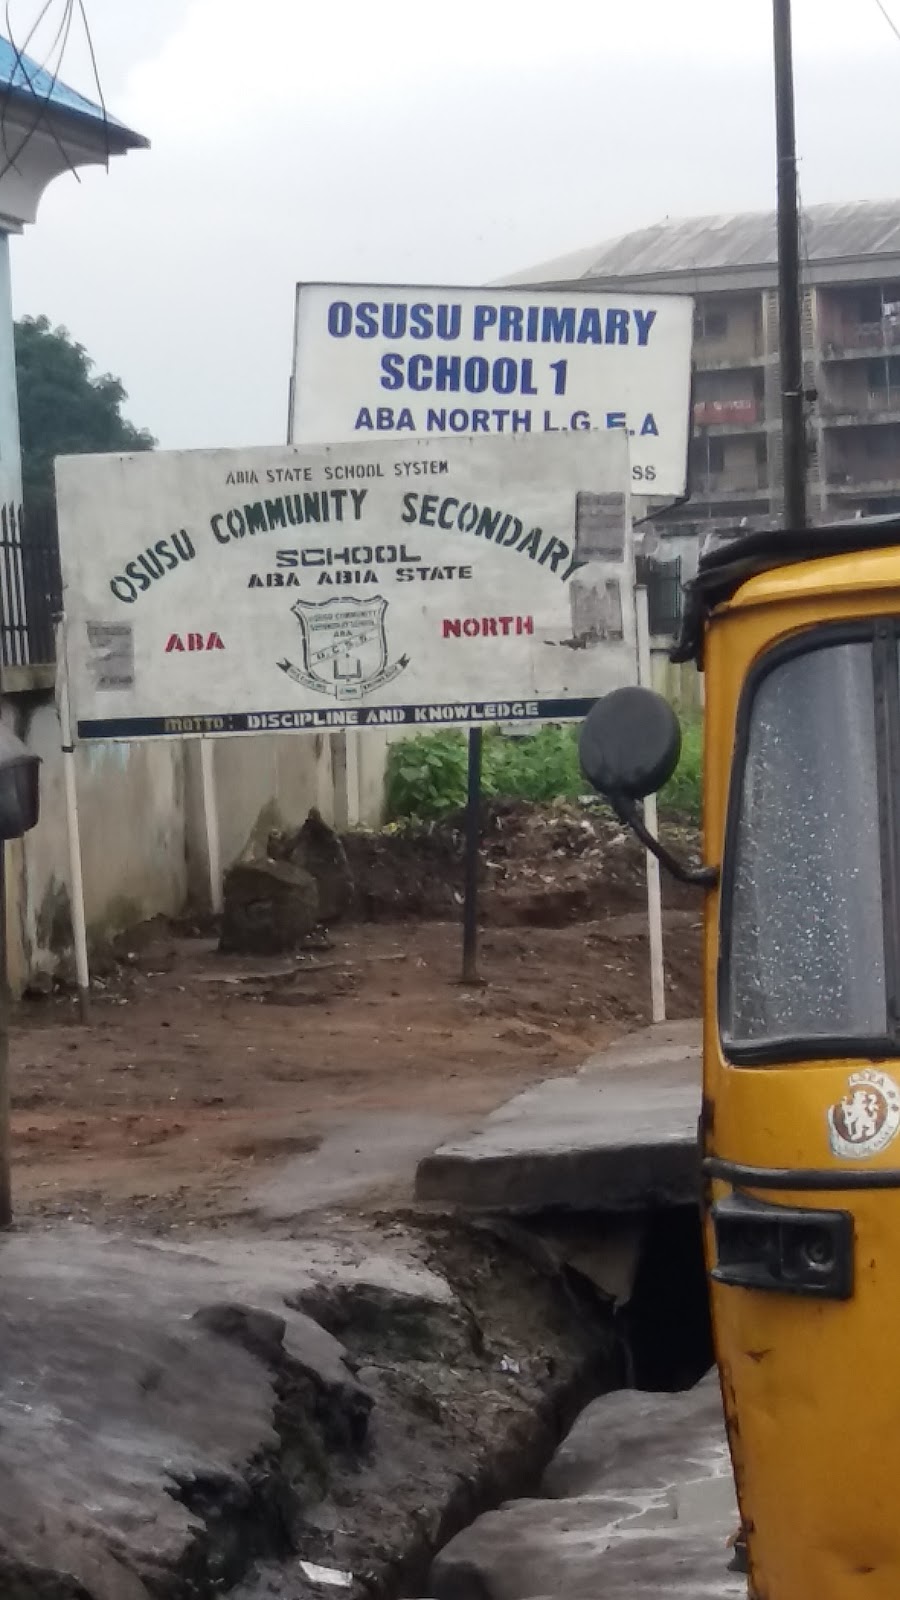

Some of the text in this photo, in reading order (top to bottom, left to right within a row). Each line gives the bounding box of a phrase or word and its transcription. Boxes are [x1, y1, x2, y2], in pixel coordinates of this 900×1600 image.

[328, 301, 656, 346] OSUSU PRIMARY
[380, 353, 568, 395] SCHOOL 1
[354, 407, 415, 431] ABA
[427, 409, 532, 433] NORTH
[226, 460, 449, 485] ABIA STATE SCHOOL SYSTEM
[109, 488, 590, 604] OSUSU COMMUNITY SECONDARY
[277, 546, 421, 567] SCHOOL
[248, 565, 473, 588] ABA ABIA STATE
[165, 615, 534, 652] ABA NORTH
[247, 711, 359, 729] DISCIPLINE
[365, 709, 405, 725] AND
[414, 702, 539, 722] KNOWLEDGE
